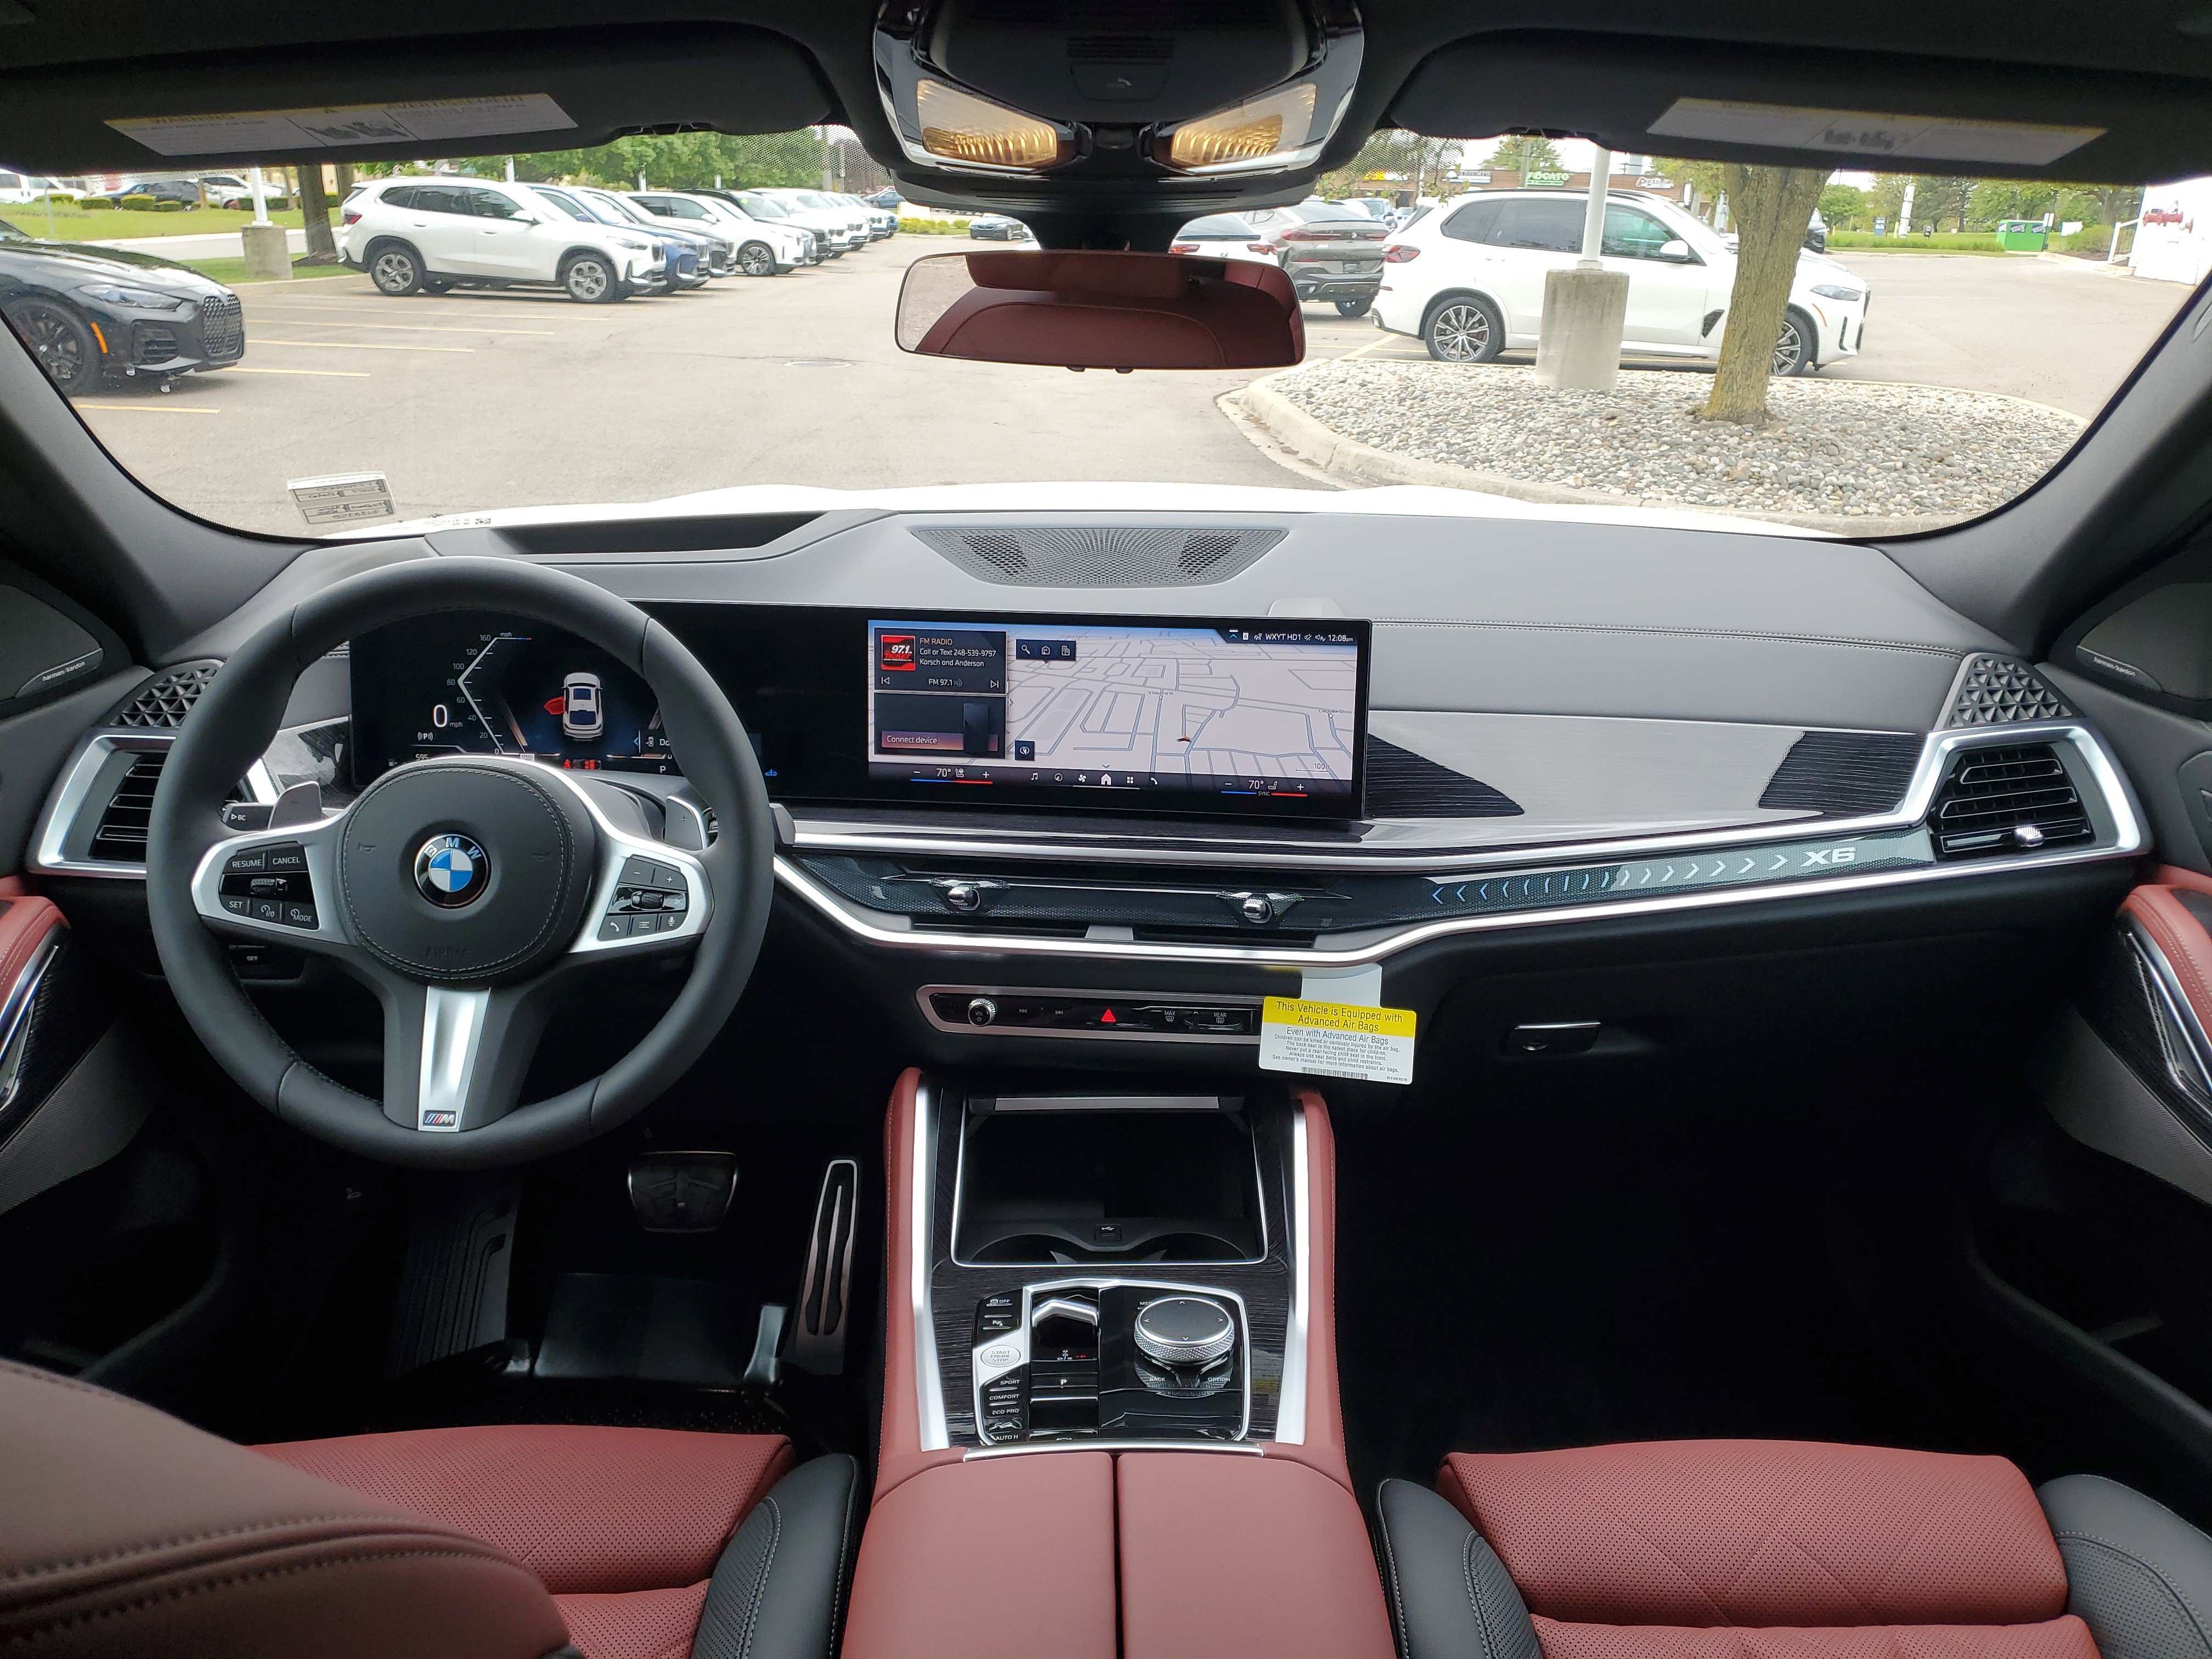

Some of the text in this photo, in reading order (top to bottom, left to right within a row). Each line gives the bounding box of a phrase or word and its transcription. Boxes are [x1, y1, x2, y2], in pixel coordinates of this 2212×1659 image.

[1265, 633, 1286, 641] WXYT
[1328, 634, 1353, 643] 12:08pm
[891, 645, 910, 654] 97.1
[919, 647, 931, 656] Call
[953, 649, 997, 657] 248-539-9797
[43, 662, 85, 681] harman/kardon
[433, 704, 448, 727] 0
[887, 735, 915, 743] Connect
[660, 765, 666, 774] P
[936, 768, 951, 777] 70°
[1248, 780, 1264, 789] 70°
[424, 837, 482, 860] BMW
[1799, 847, 1857, 867] X6
[232, 856, 301, 868] RESUME CANCEL
[293, 914, 313, 922] MODE
[1276, 1001, 1403, 1023] This Vehicle is Equipped with
[1297, 1014, 1379, 1033] Advanced Air Bags
[1286, 1026, 1389, 1046] Even with Advanced Air Bags
[1338, 1061, 1364, 1069] information
